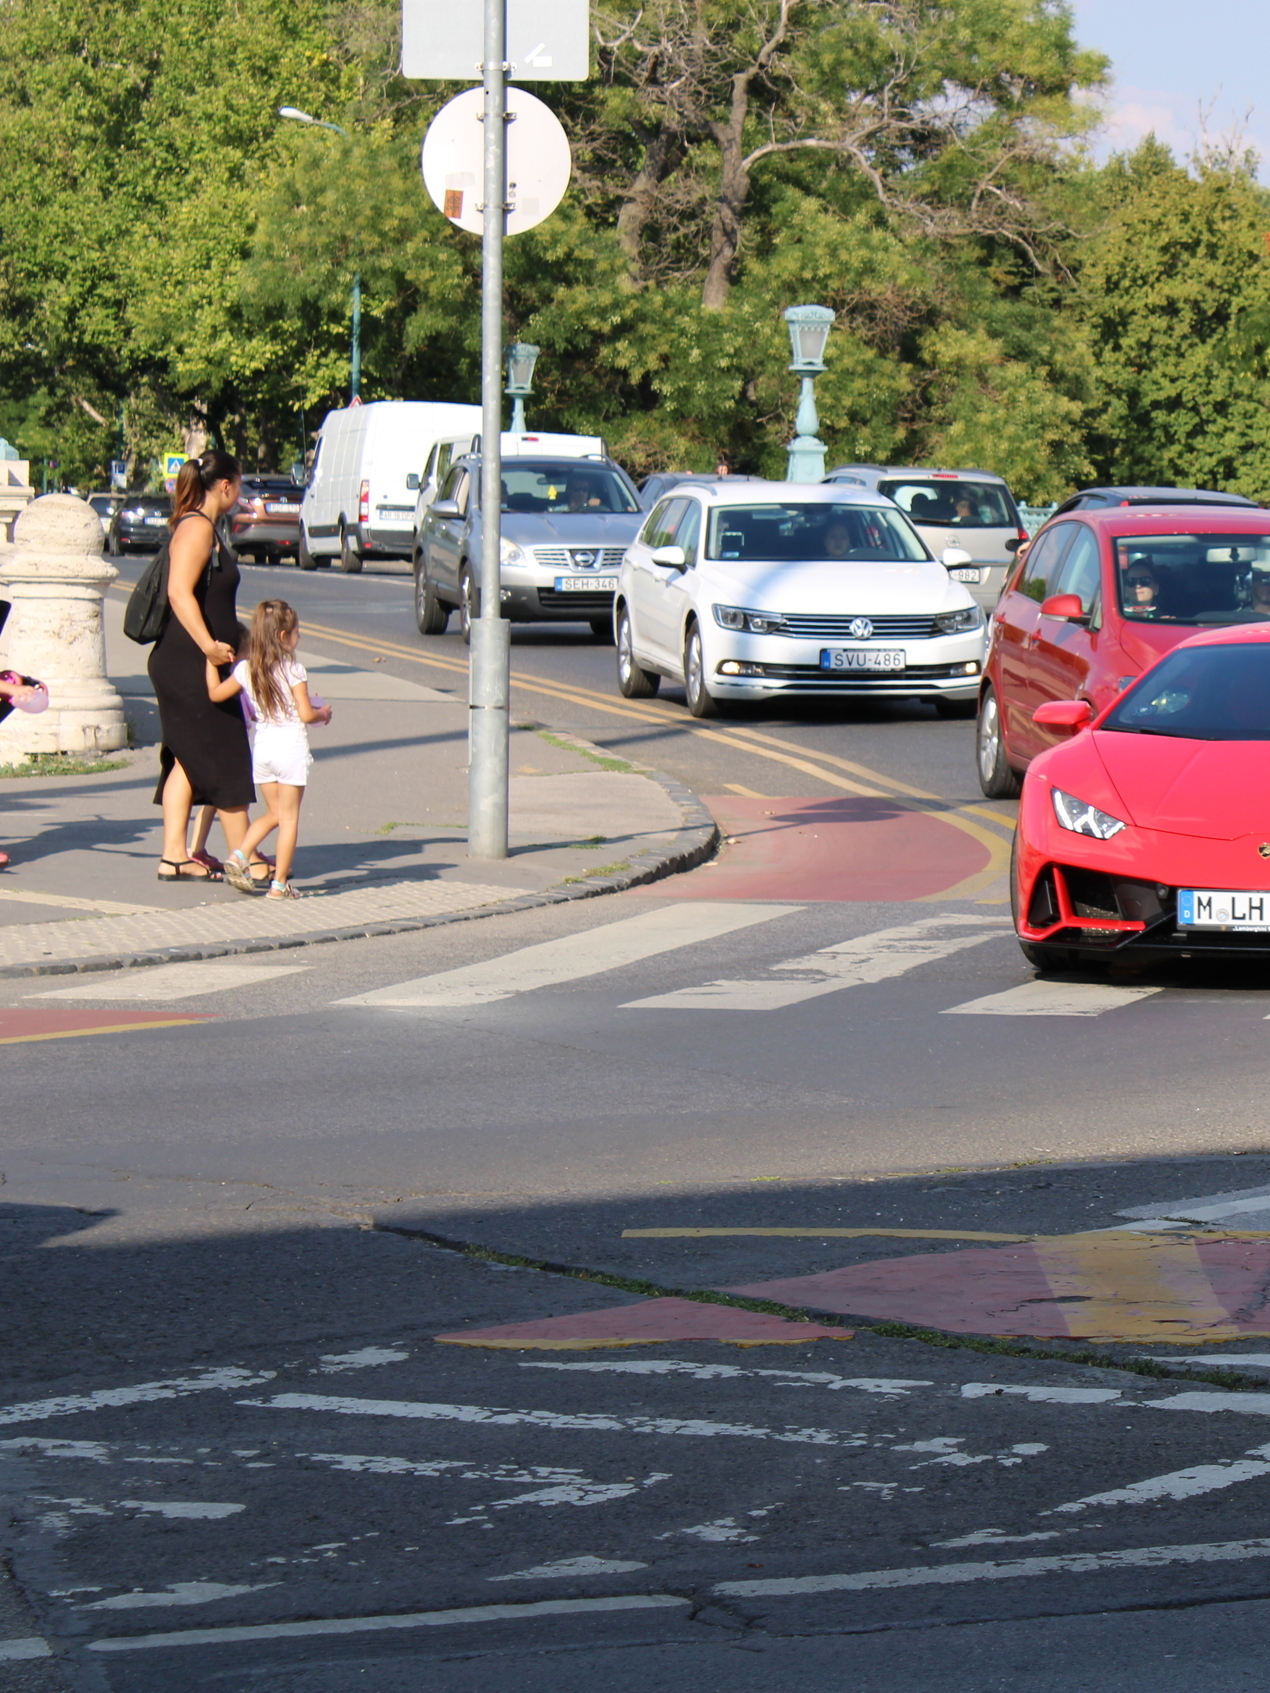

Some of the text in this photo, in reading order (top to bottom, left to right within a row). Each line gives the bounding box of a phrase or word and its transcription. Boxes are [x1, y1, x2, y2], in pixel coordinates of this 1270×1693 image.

[565, 578, 615, 590] SEH-346
[834, 653, 901, 667] SVU-486
[1183, 910, 1191, 918] D
[1197, 896, 1212, 919] M
[1231, 896, 1264, 921] LH
